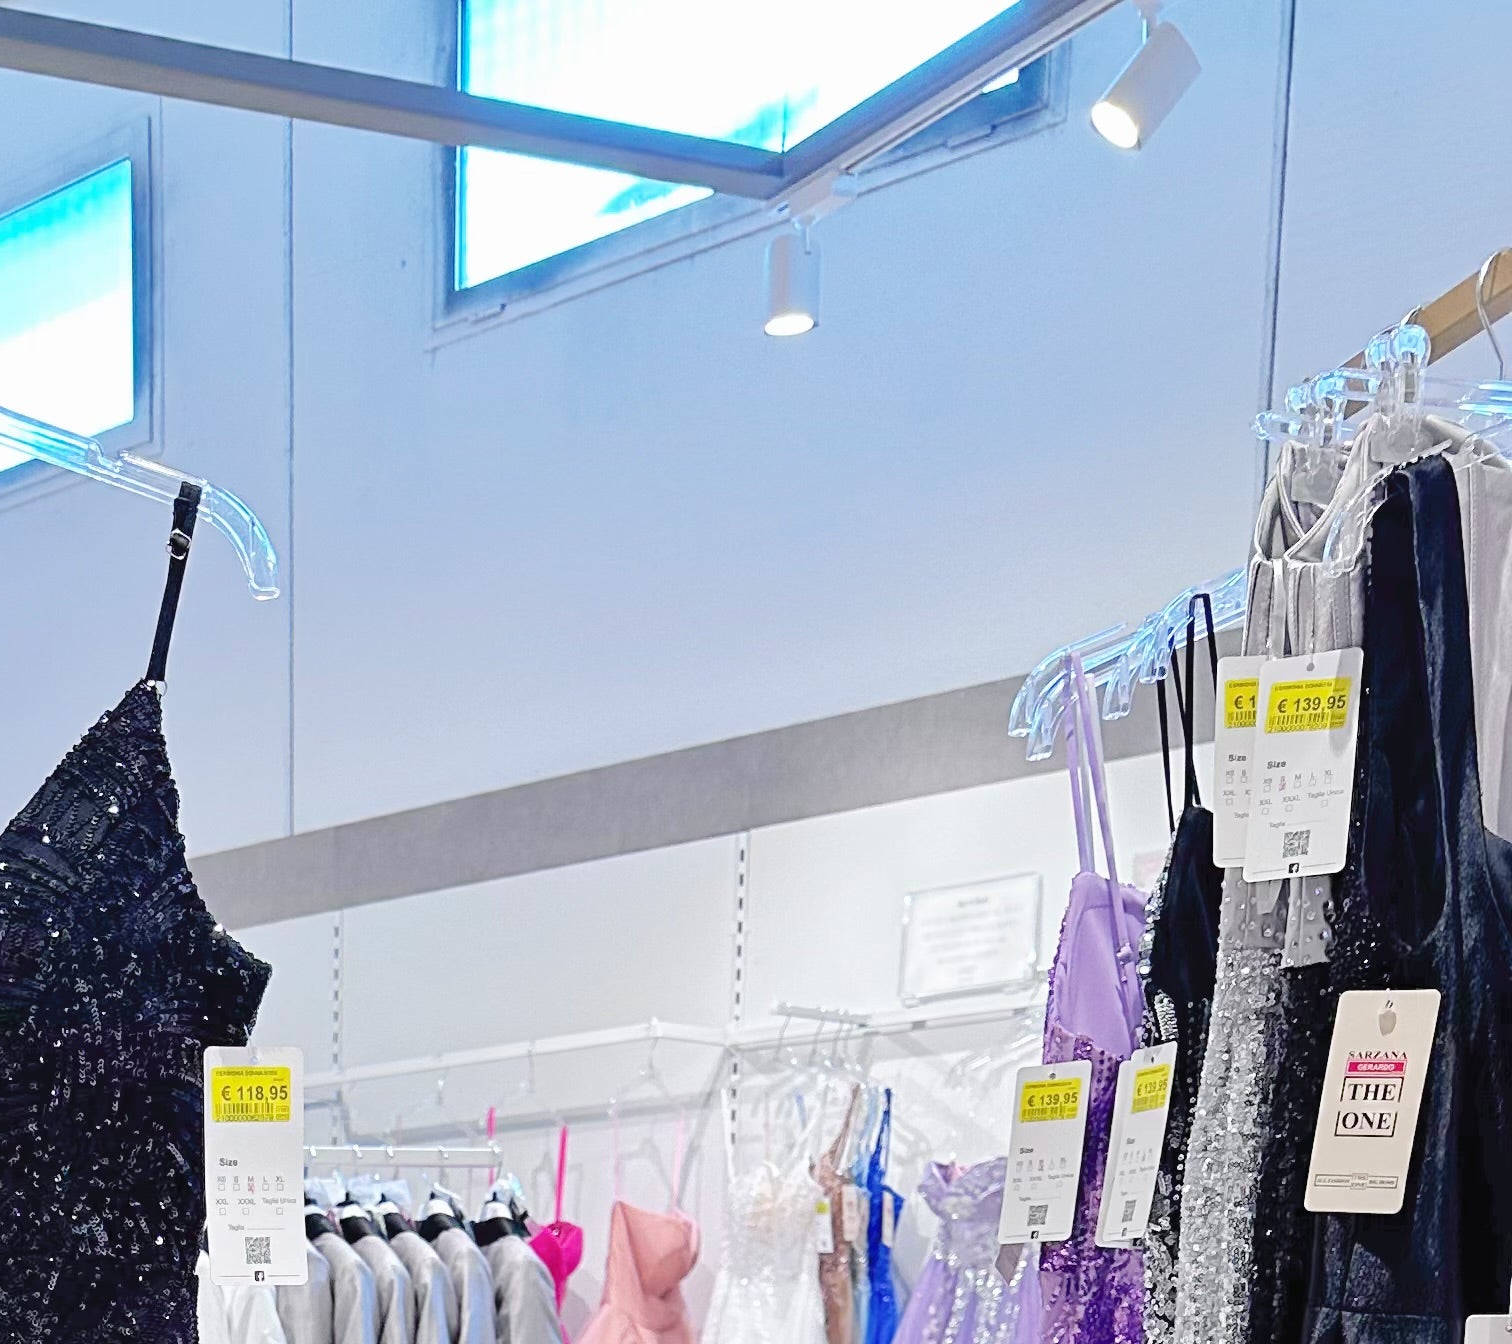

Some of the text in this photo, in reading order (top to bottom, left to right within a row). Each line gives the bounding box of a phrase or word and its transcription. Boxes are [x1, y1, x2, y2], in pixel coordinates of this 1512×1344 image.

[1277, 694, 1347, 713] € 139,95
[1267, 761, 1287, 769] Size
[1349, 1050, 1407, 1059] SARZANA
[221, 1085, 288, 1103] € 118,95
[1028, 1091, 1078, 1107] € 139,95
[1348, 1083, 1396, 1101] THE
[1342, 1111, 1392, 1130] ONE
[219, 1157, 238, 1166] Size
